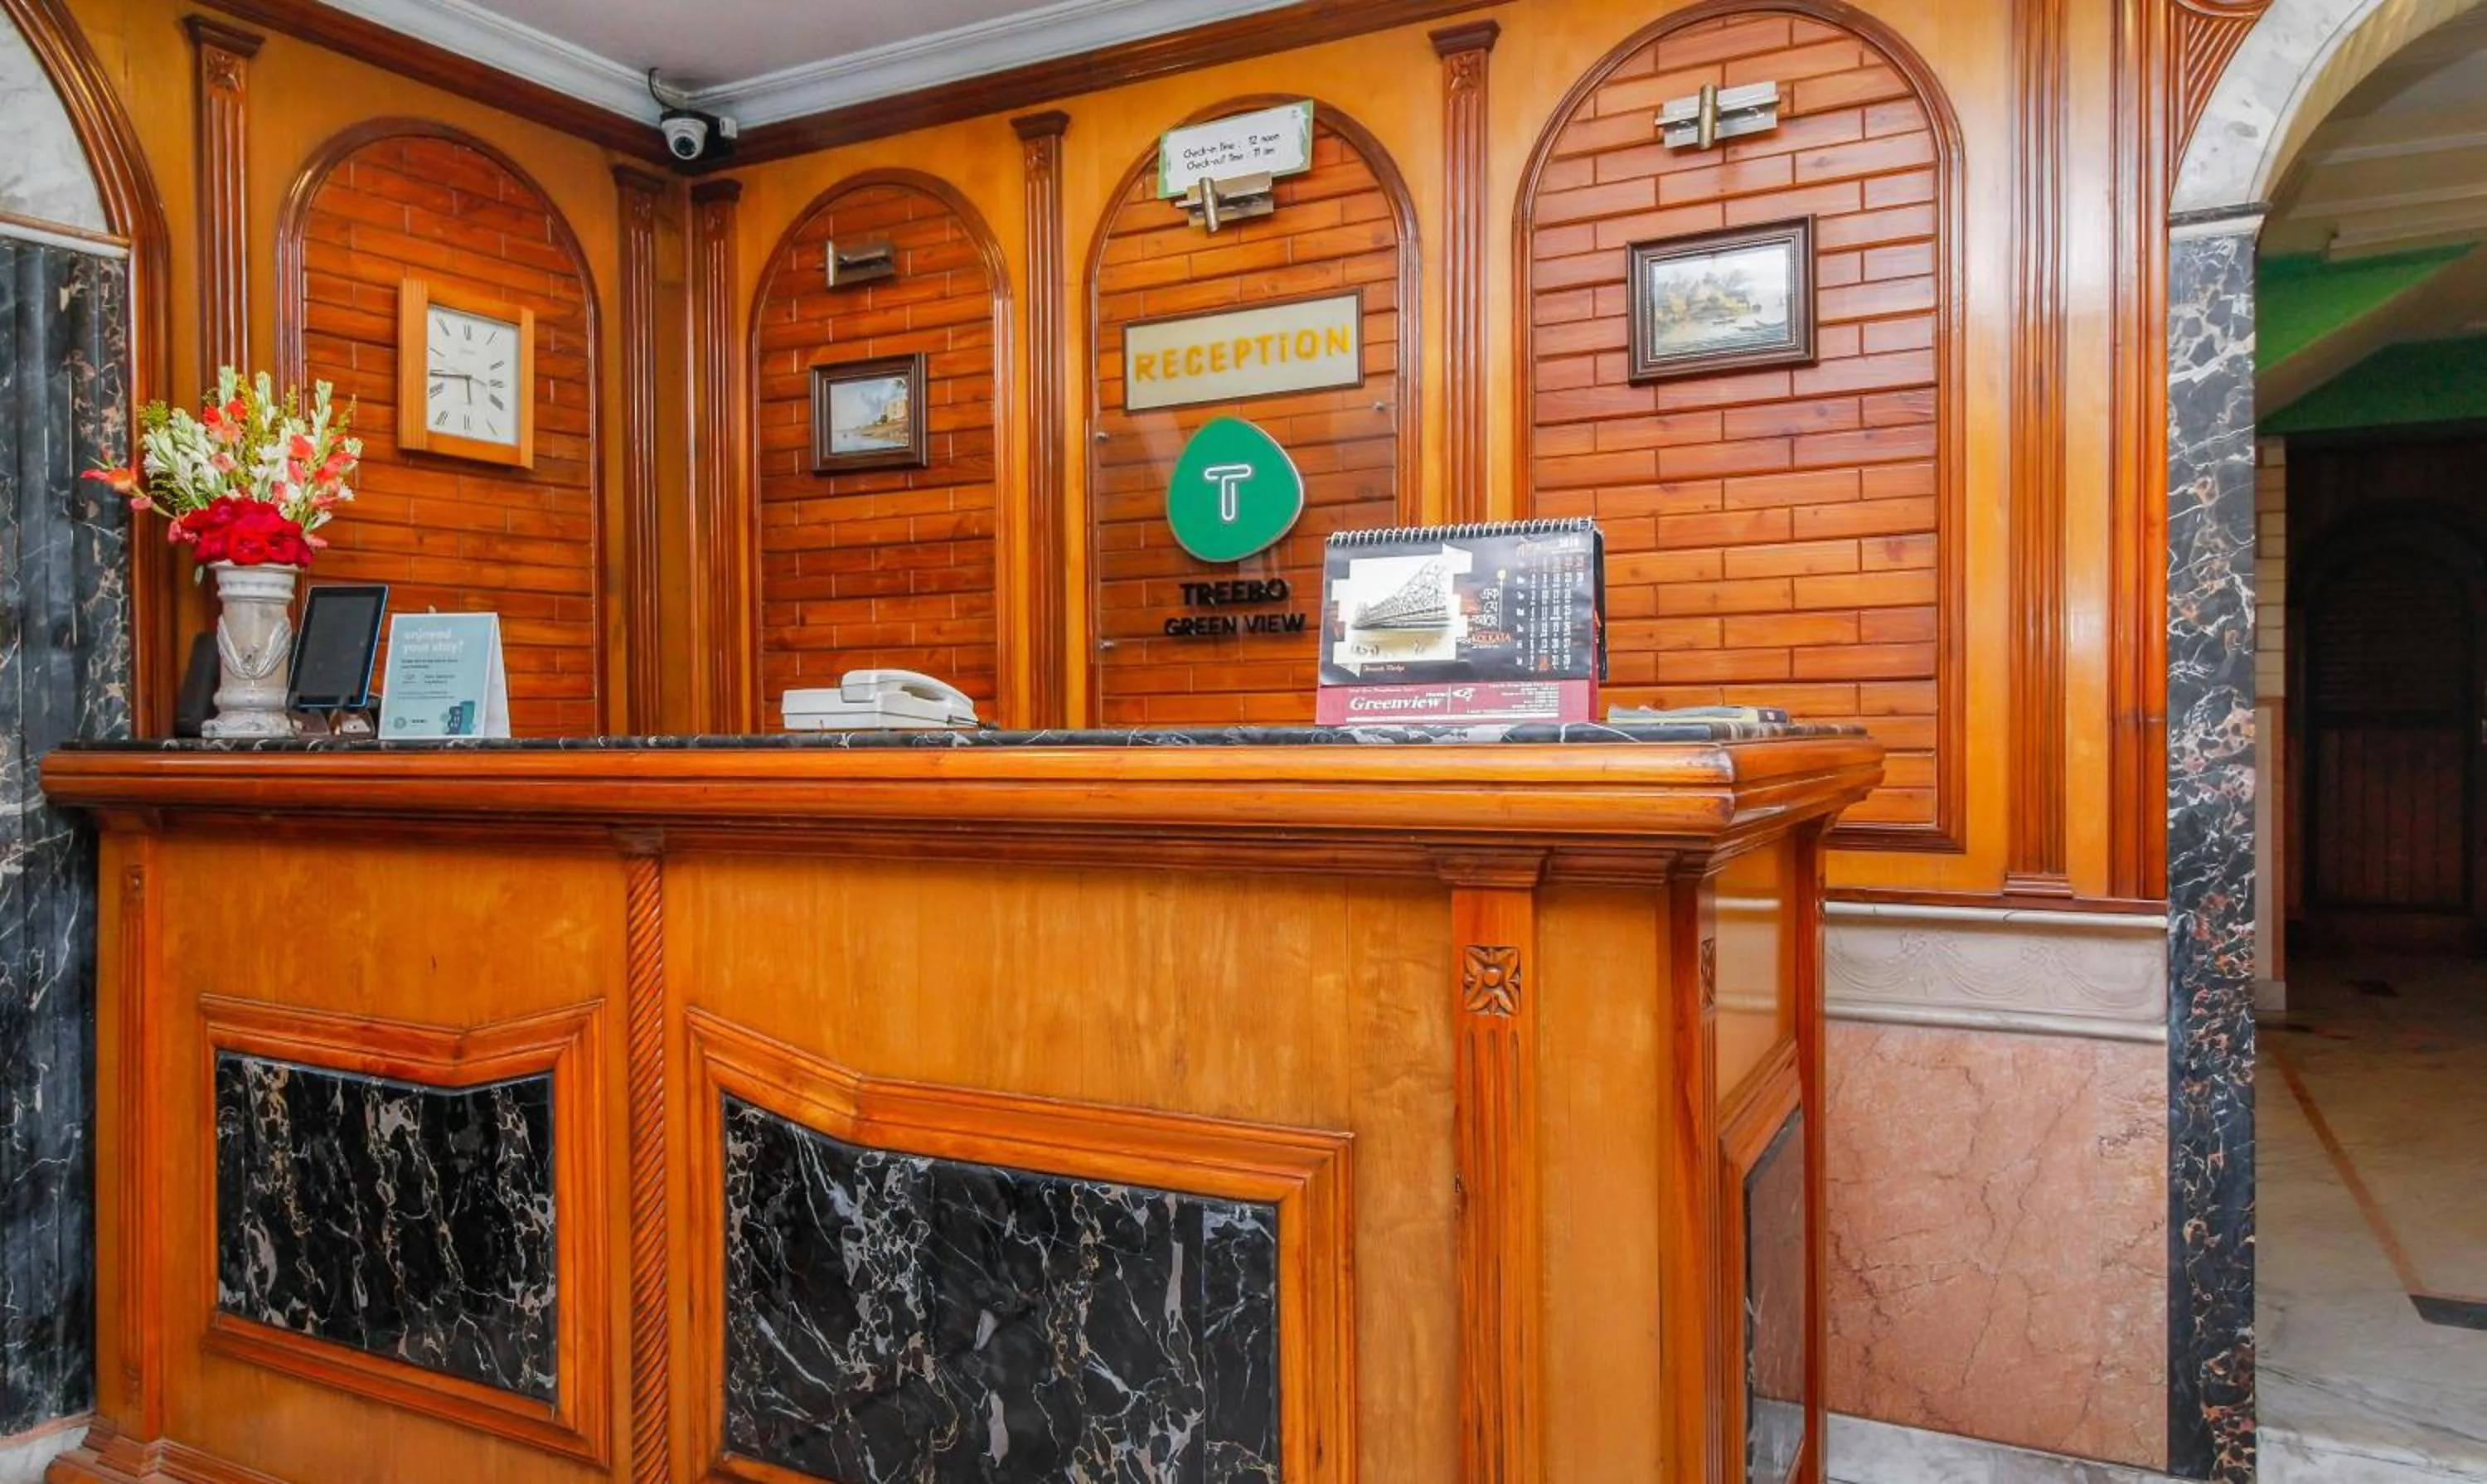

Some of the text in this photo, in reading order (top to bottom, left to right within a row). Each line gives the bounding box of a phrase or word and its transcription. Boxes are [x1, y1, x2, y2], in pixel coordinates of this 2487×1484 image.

[1134, 323, 1351, 383] RECEPTION
[1205, 463, 1252, 521] T
[1180, 578, 1289, 606] TREEBO
[1164, 613, 1307, 636] GREEN VIEW
[1350, 696, 1442, 710] Greenview
